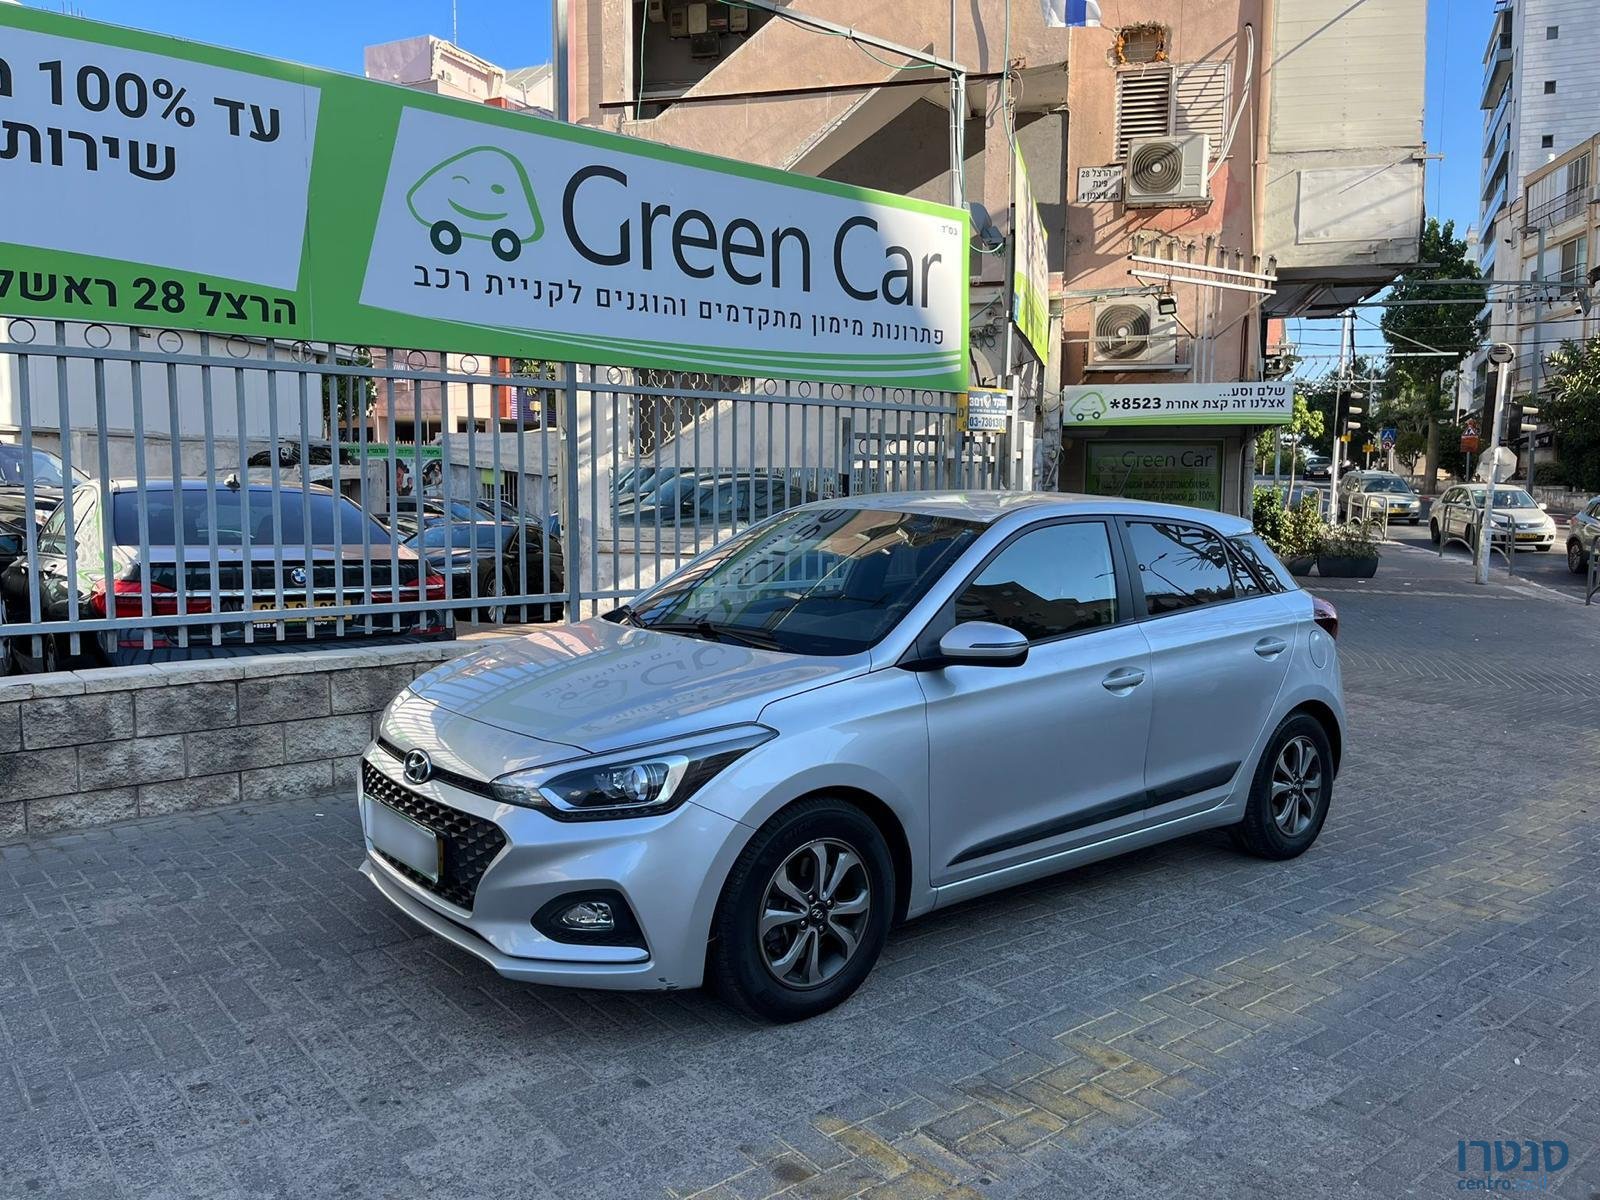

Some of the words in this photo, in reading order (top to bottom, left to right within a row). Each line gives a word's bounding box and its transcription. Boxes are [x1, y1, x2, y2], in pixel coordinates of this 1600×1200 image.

[39, 60, 195, 127] 100%
[213, 96, 280, 142] עד
[0, 120, 176, 181] שירות
[1081, 170, 1090, 178] 28
[1092, 169, 1111, 177] הרצל
[1092, 180, 1108, 188] פינת
[563, 165, 811, 292] Green
[833, 216, 942, 308] Car
[414, 265, 470, 292] רכב
[132, 278, 185, 313] 28
[199, 282, 296, 324] הרצל
[485, 274, 582, 308] לקניית
[597, 288, 686, 316] והוגנים
[700, 301, 801, 330] מתקדמים
[812, 315, 863, 336] מימון
[872, 321, 944, 345] פתרונות
[1250, 397, 1285, 408] אצלנו
[1257, 385, 1285, 396] שלם
[1165, 400, 1199, 409] אחרת
[1203, 399, 1228, 411] קצת
[1232, 399, 1247, 408] זה
[1121, 450, 1176, 468] Green
[1180, 451, 1214, 468] Car
